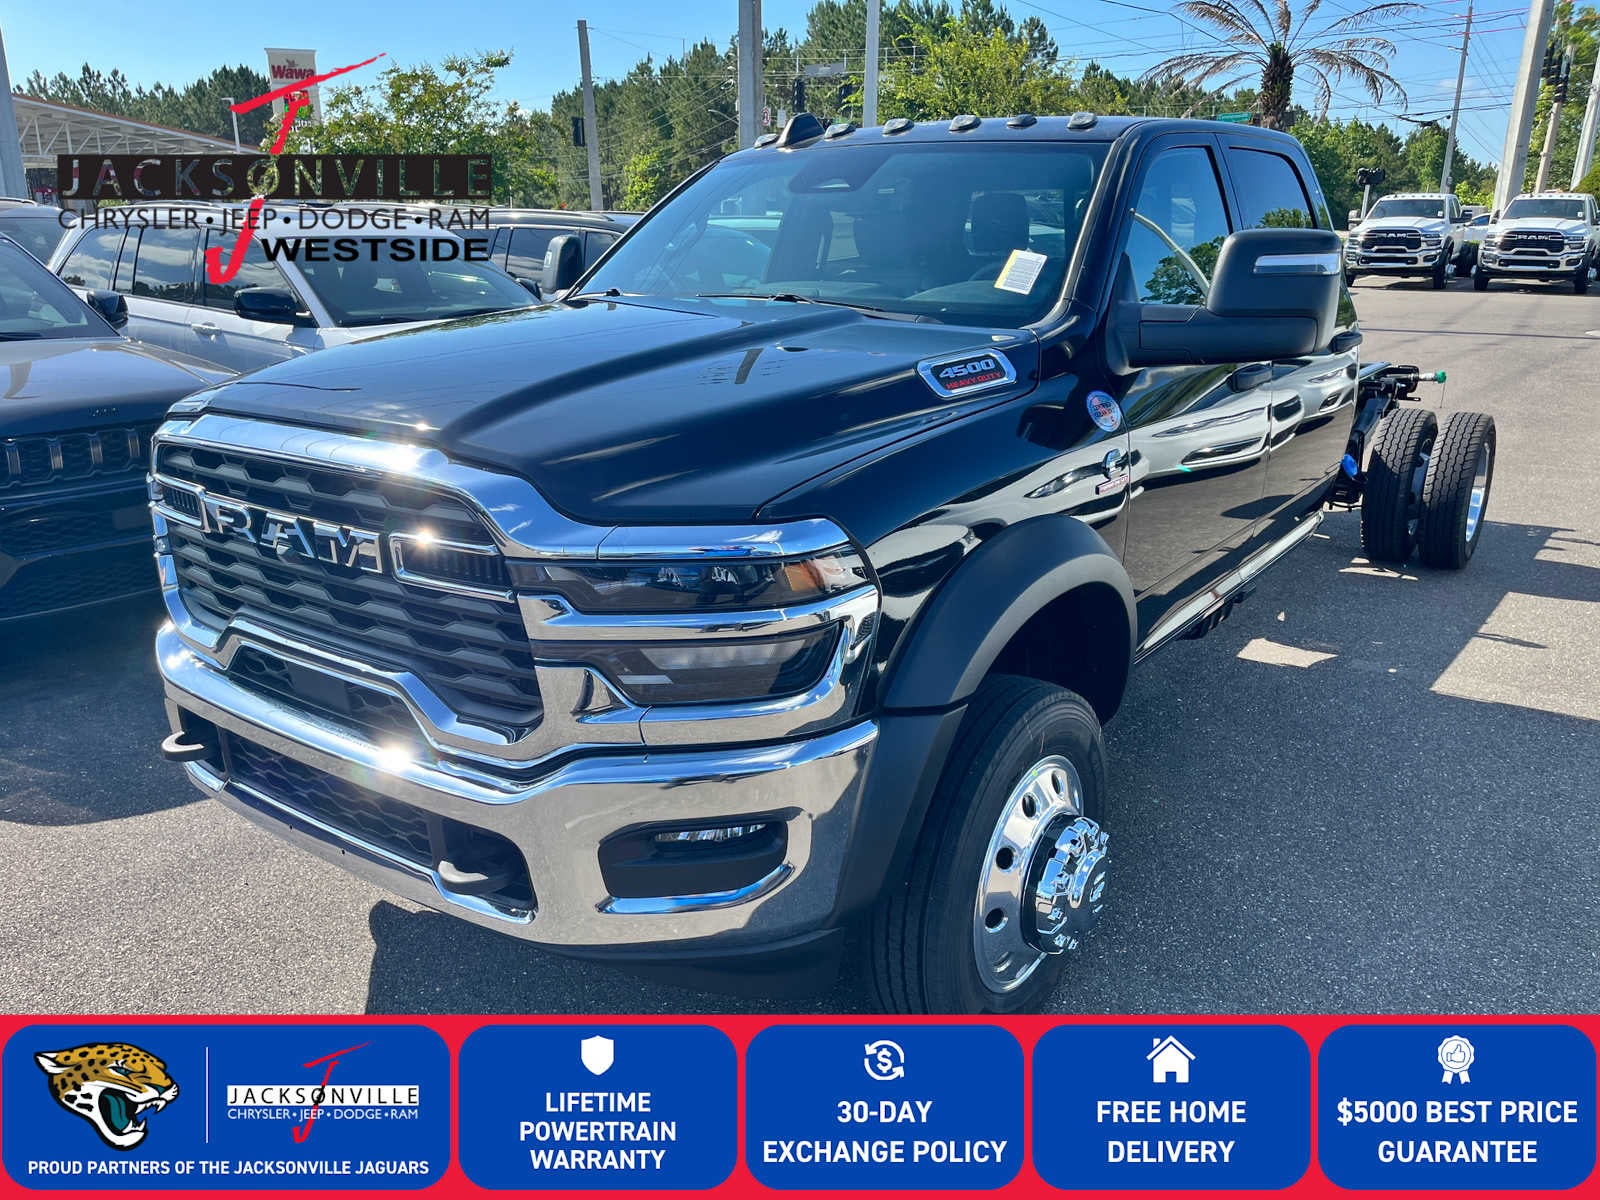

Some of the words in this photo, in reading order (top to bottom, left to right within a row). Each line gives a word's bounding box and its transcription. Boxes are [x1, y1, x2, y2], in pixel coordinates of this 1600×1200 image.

[271, 64, 315, 79] Wawa
[940, 359, 996, 378] 4500
[946, 377, 976, 390] HEAVY
[977, 371, 1001, 383] DUTY
[202, 491, 383, 574] RAM
